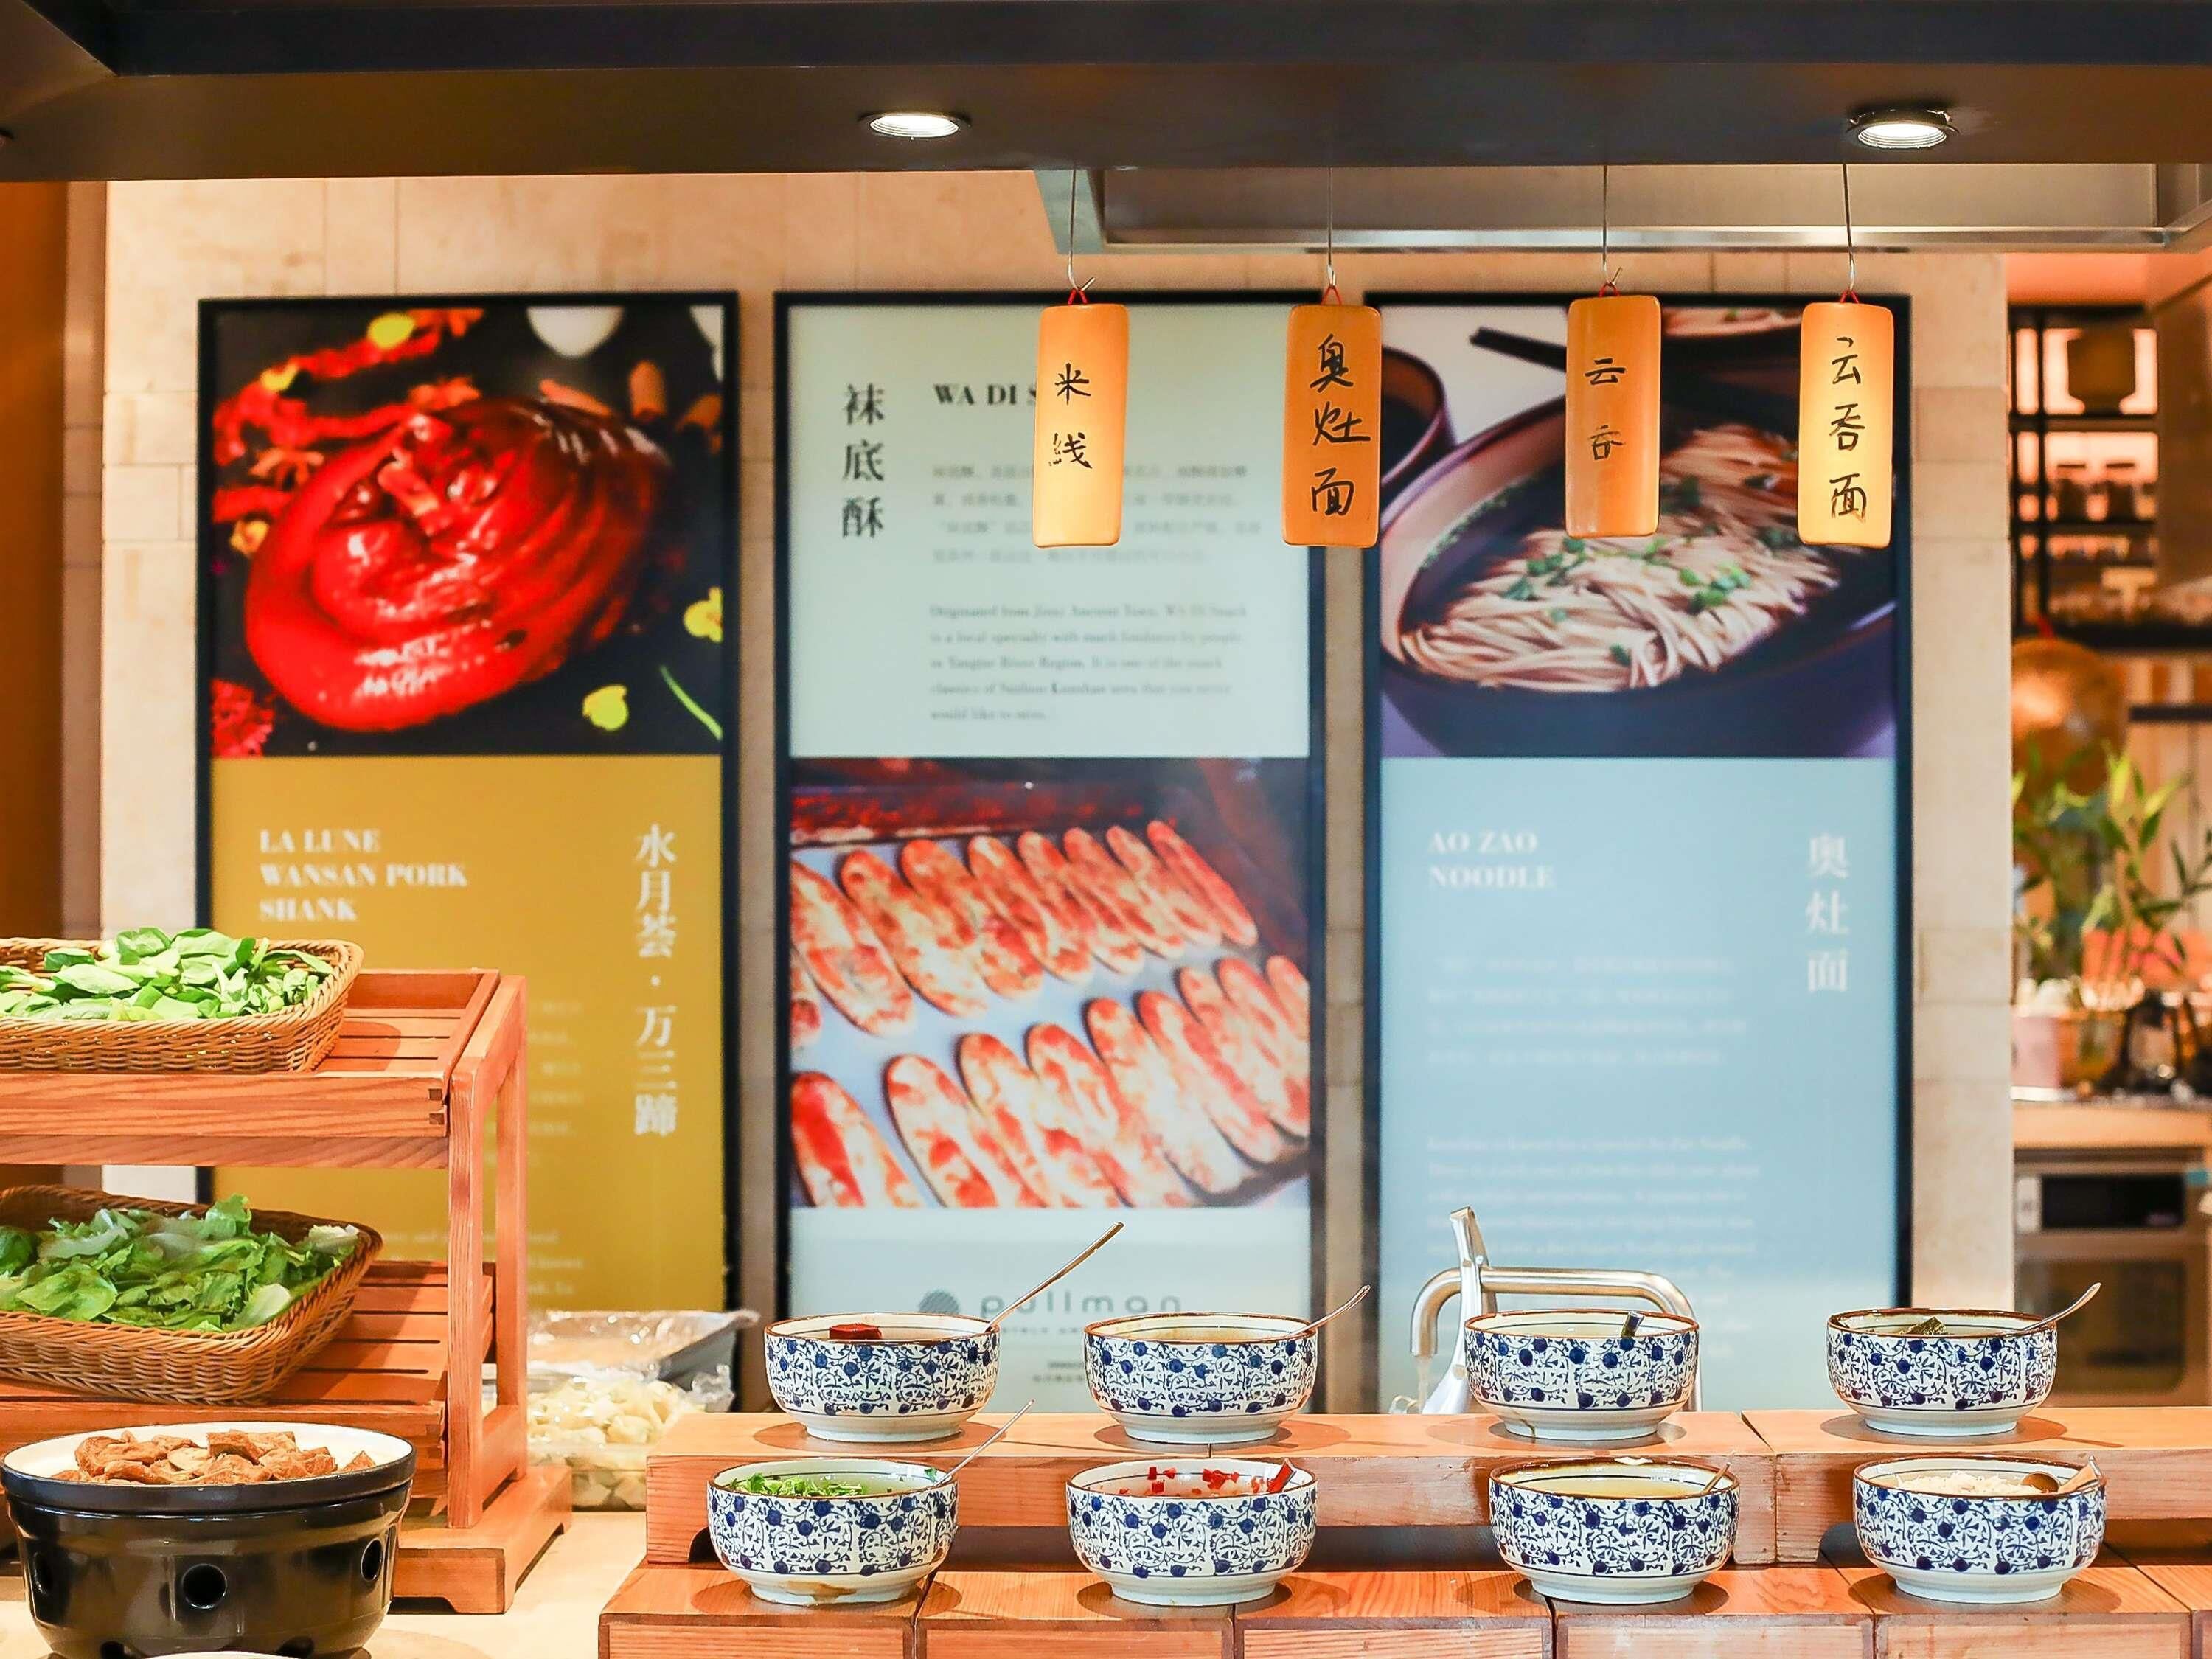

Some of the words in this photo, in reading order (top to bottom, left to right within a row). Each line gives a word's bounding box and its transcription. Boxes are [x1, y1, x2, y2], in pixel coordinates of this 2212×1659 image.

[933, 383, 975, 406] WA
[987, 383, 1018, 406] DI
[1048, 362, 1093, 469] 米线
[1310, 333, 1371, 516] 奥灶面
[1585, 358, 1626, 461] 云吞
[842, 382, 885, 538] 袜底酥
[1829, 336, 1867, 523] 云吞面
[259, 829, 296, 854] LA
[1427, 830, 1471, 855] AO
[1478, 830, 1539, 855] ZAO
[259, 863, 378, 887] WANSAN
[386, 863, 467, 887] PORK
[1429, 865, 1557, 889] NOODLE
[259, 897, 358, 922] SHANK
[1806, 833, 1850, 992] 奥灶面
